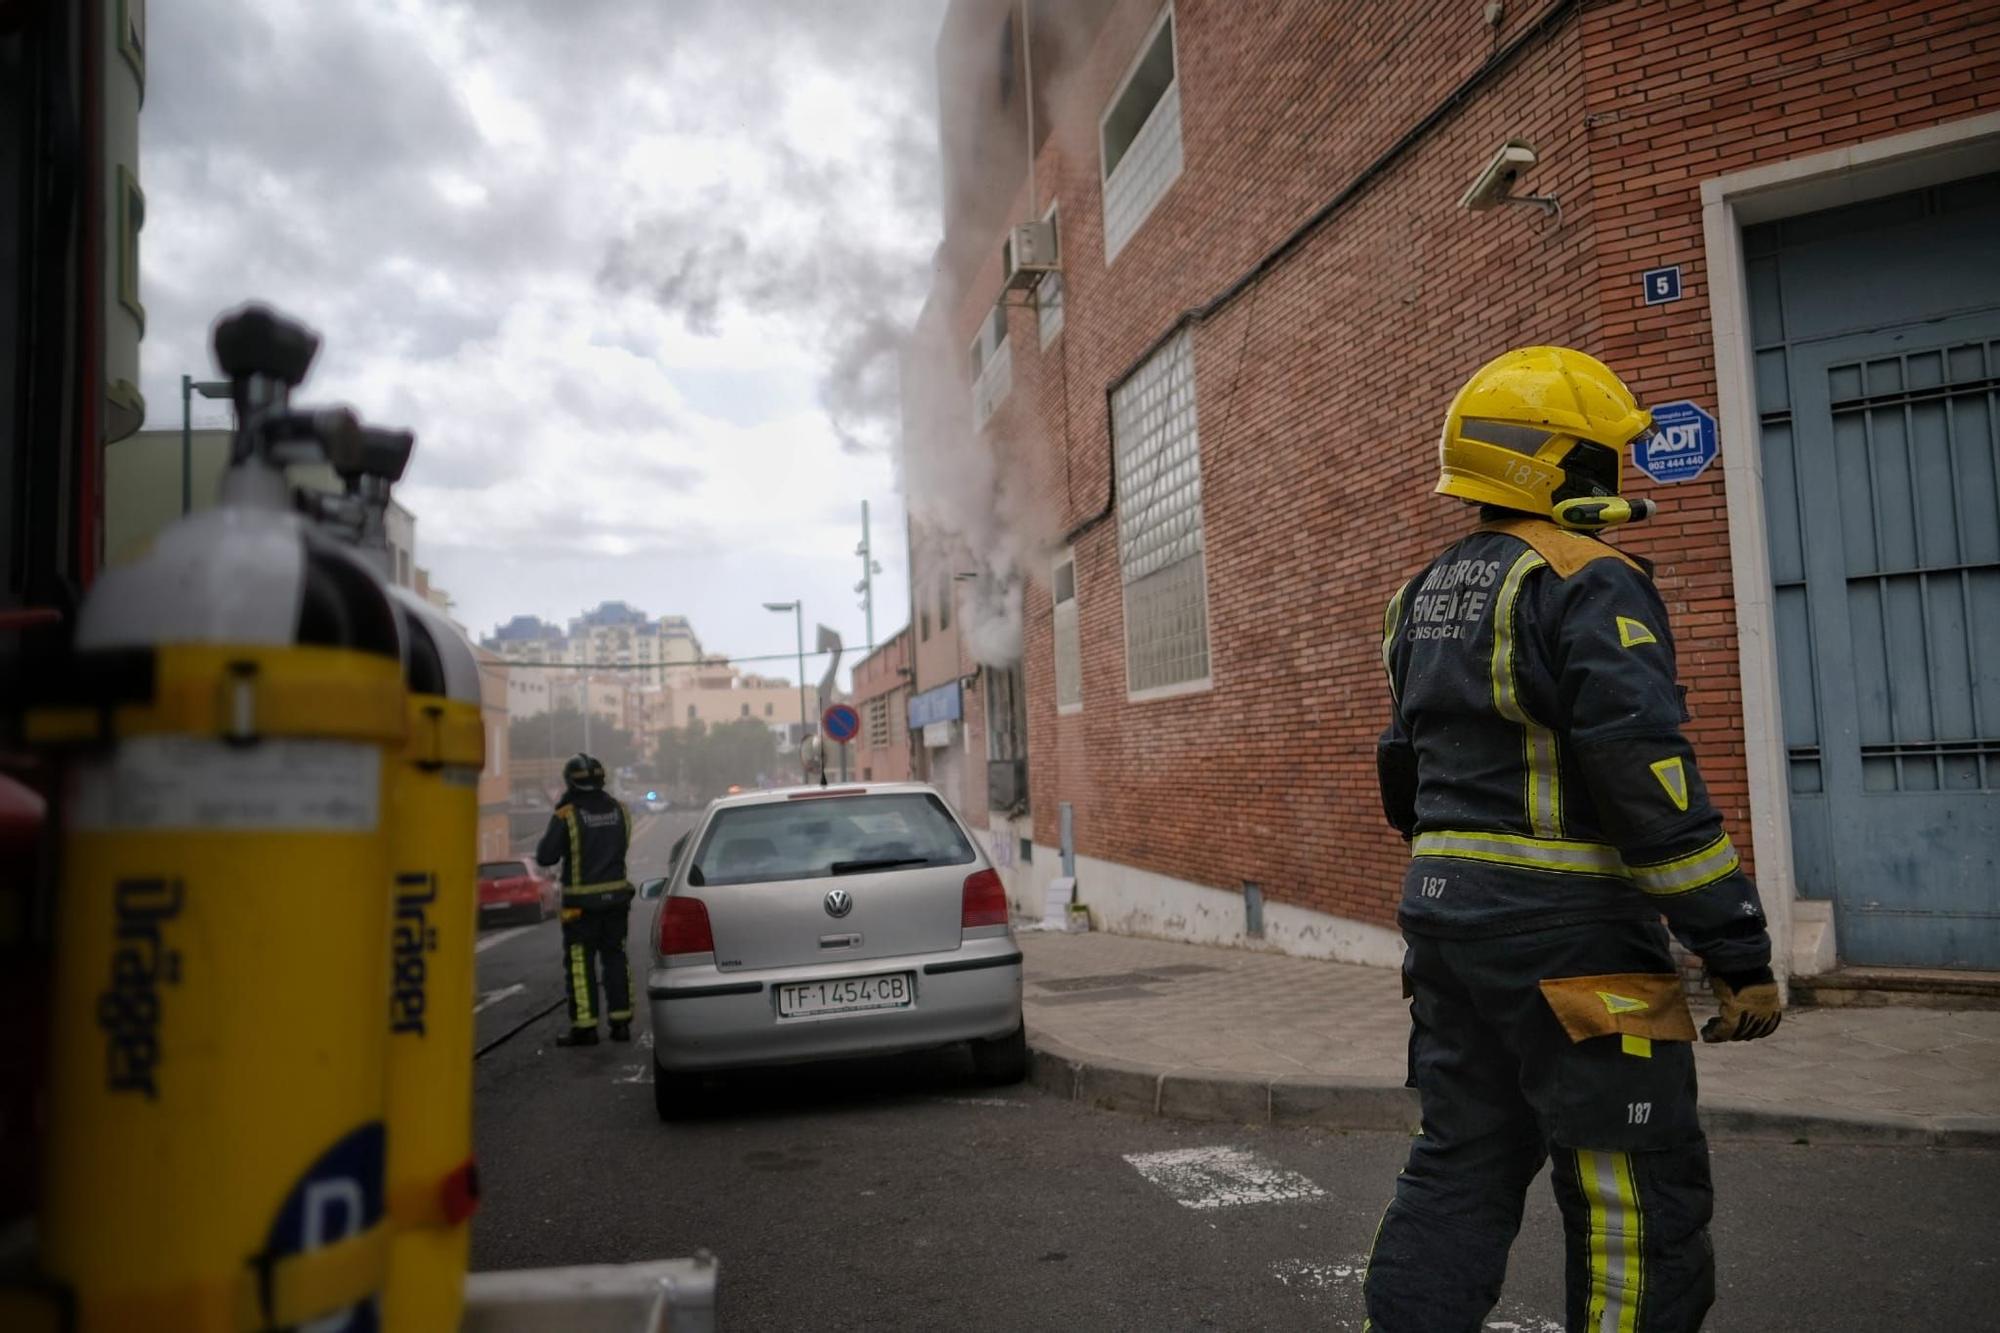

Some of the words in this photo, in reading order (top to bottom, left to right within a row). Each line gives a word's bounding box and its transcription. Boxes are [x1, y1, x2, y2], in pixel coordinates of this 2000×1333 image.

[1656, 276, 1669, 295] 5
[1648, 423, 1700, 455] ADT
[1504, 458, 1548, 489] 187
[1648, 460, 1665, 471] 902
[1666, 458, 1684, 468] 444
[1685, 455, 1704, 465] 440
[1421, 876, 1447, 899] 187
[1627, 1102, 1651, 1125] 187
